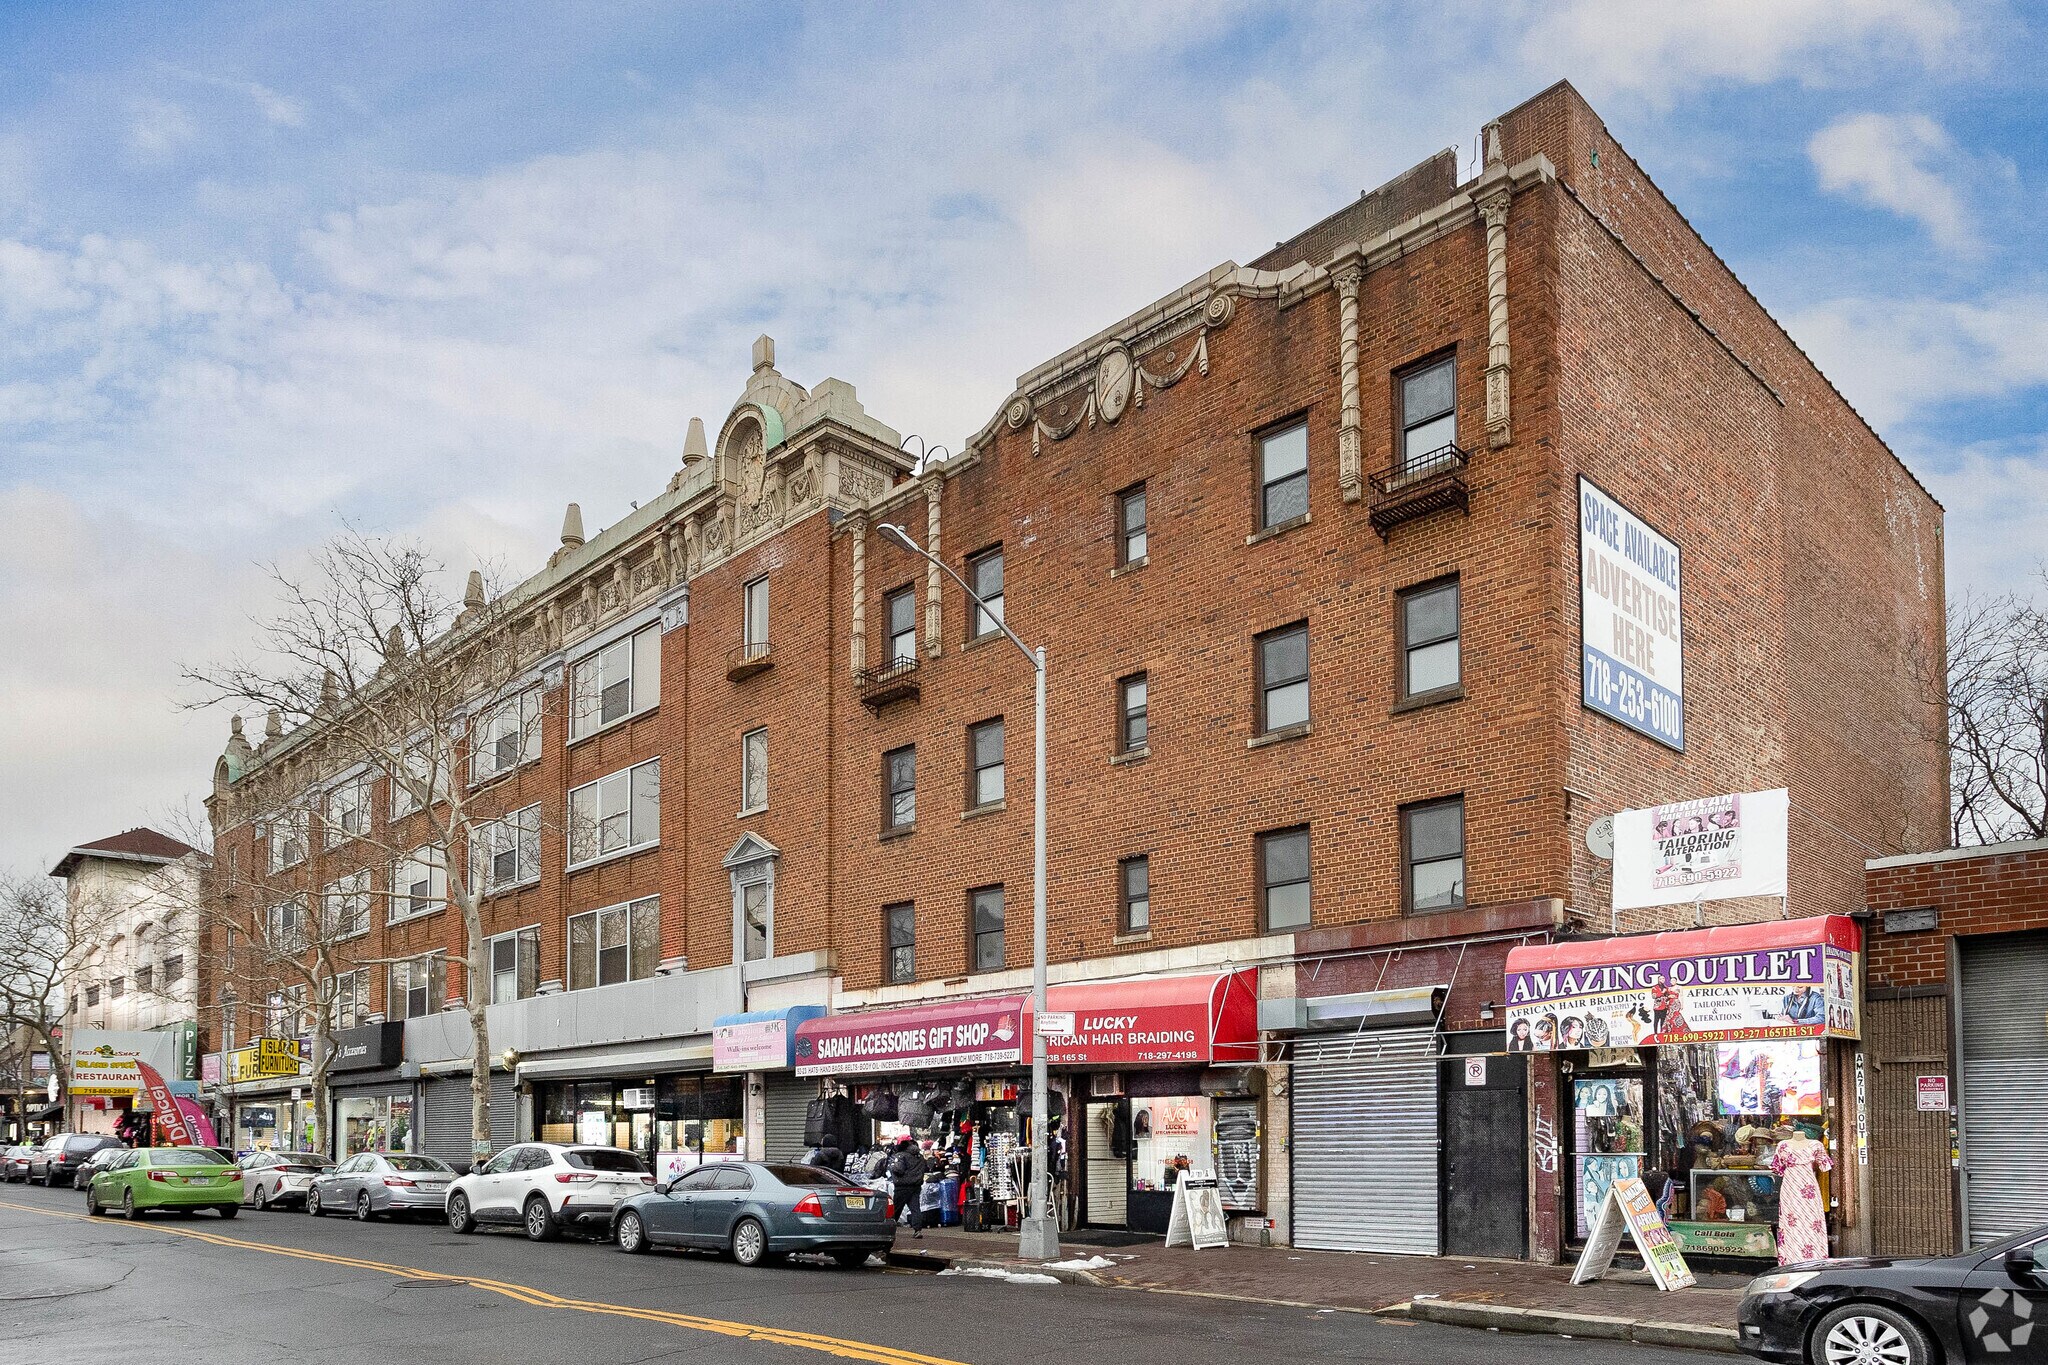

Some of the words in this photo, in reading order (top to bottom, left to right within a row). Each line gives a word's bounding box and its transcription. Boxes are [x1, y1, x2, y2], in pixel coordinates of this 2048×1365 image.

[1584, 492, 1619, 552] SPACE
[1624, 521, 1676, 591] AVAILABLE
[1587, 547, 1677, 643] ADVERTISE
[1612, 612, 1655, 676] HERE
[1587, 653, 1680, 740] 718-253-6100
[1658, 794, 1734, 816] AFRICAN
[1660, 812, 1681, 822] HAIR
[1684, 804, 1733, 818] BRAIDING
[1658, 829, 1736, 851] TAILORING
[1663, 840, 1730, 858] ALTERATION
[1657, 867, 1738, 888] 718-690-5922
[1510, 963, 1662, 1004] AMAZING
[1669, 948, 1816, 986] OUTLET
[1687, 987, 1739, 998] AFRICAN
[1743, 986, 1786, 996] WEARS
[1510, 1004, 1555, 1018] AFRICAN
[1559, 1000, 1586, 1011] HAIR
[1590, 992, 1646, 1006] BRAIDING
[1693, 1000, 1736, 1009] TAILORING
[1083, 1016, 1138, 1030] LUCKY
[1689, 1013, 1742, 1022] ALTERATIONS
[818, 1037, 851, 1059] SARAH
[853, 1028, 926, 1056] ACCESSORIES
[929, 1026, 953, 1050] GIFT
[956, 1022, 989, 1047] SHOP
[1046, 1034, 1088, 1047] RICAN
[1092, 1033, 1123, 1045] HAIR
[1128, 1030, 1195, 1044] BRAIDING
[1663, 1031, 1724, 1043] 718-690-5922
[1733, 1029, 1760, 1039] 92-27
[1763, 1028, 1797, 1038] 165TH
[1800, 1026, 1815, 1036] ST
[727, 1044, 749, 1053] Walk-ins
[1062, 1053, 1076, 1061] 165
[1078, 1053, 1087, 1061] St
[1138, 1051, 1197, 1060] 718-297-4198
[76, 1060, 108, 1069] ISLAND
[110, 1060, 136, 1069] SPICE
[262, 1055, 298, 1071] FURNITURE
[881, 1060, 900, 1069] INCENSE
[902, 1058, 923, 1067] JEWELRY
[925, 1056, 947, 1066] PERFUME
[953, 1055, 966, 1063] MUCH
[968, 1053, 982, 1062] MORE
[1856, 1054, 1865, 1112] AMAZIN
[150, 1086, 188, 1140] Digicel
[1162, 1107, 1197, 1122] AVON
[1858, 1114, 1867, 1164] OUTET
